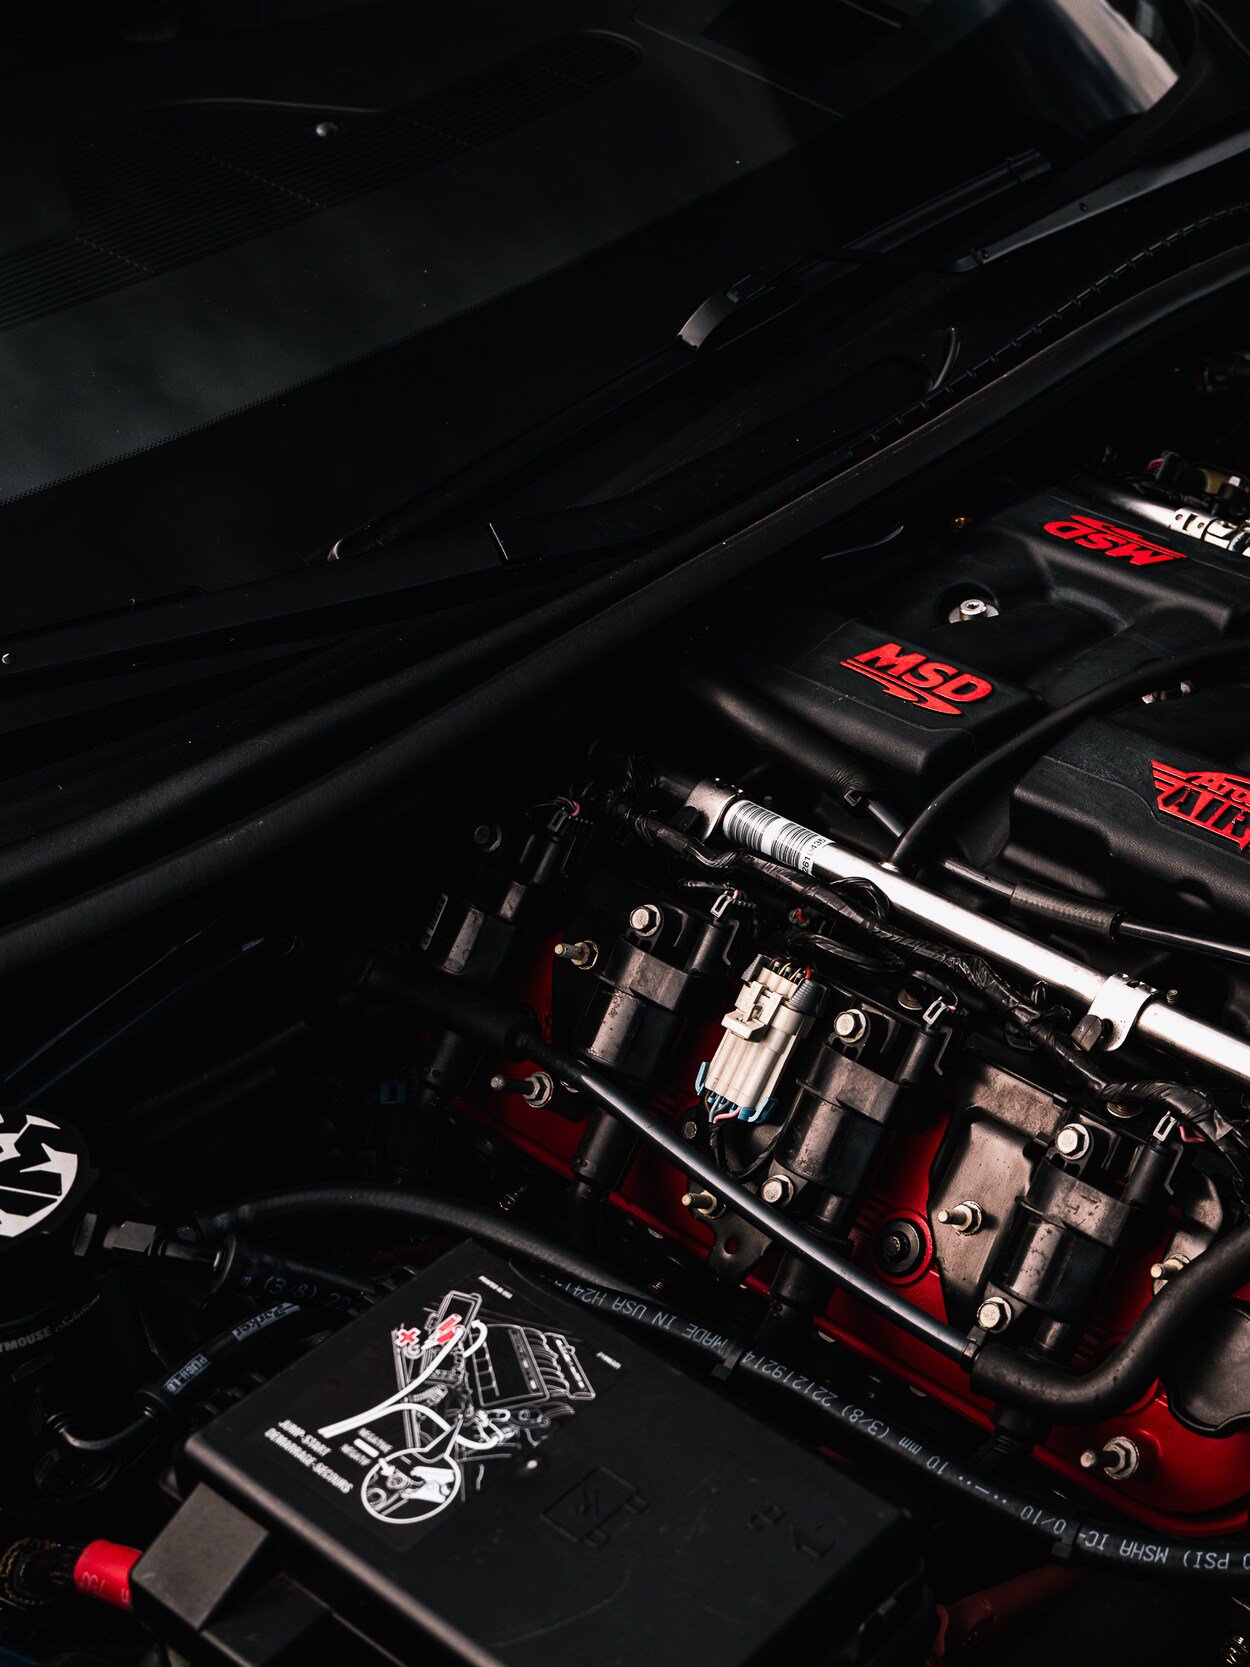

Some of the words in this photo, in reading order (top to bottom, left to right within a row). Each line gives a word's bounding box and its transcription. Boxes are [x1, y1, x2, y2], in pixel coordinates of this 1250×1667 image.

[1043, 521, 1180, 567] MSD
[854, 642, 993, 703] MSD
[232, 1302, 293, 1341] Parker
[612, 1298, 648, 1322] USA
[653, 1312, 679, 1331] IN
[686, 1322, 729, 1356] MADE
[741, 1351, 839, 1408] 221219214
[278, 1419, 333, 1457] JUMP-START
[840, 1404, 891, 1439] (3/8)
[899, 1436, 922, 1455] mm
[926, 1455, 950, 1476] 10
[1119, 1540, 1169, 1564] MSHA
[1182, 1550, 1230, 1570] PSI)
